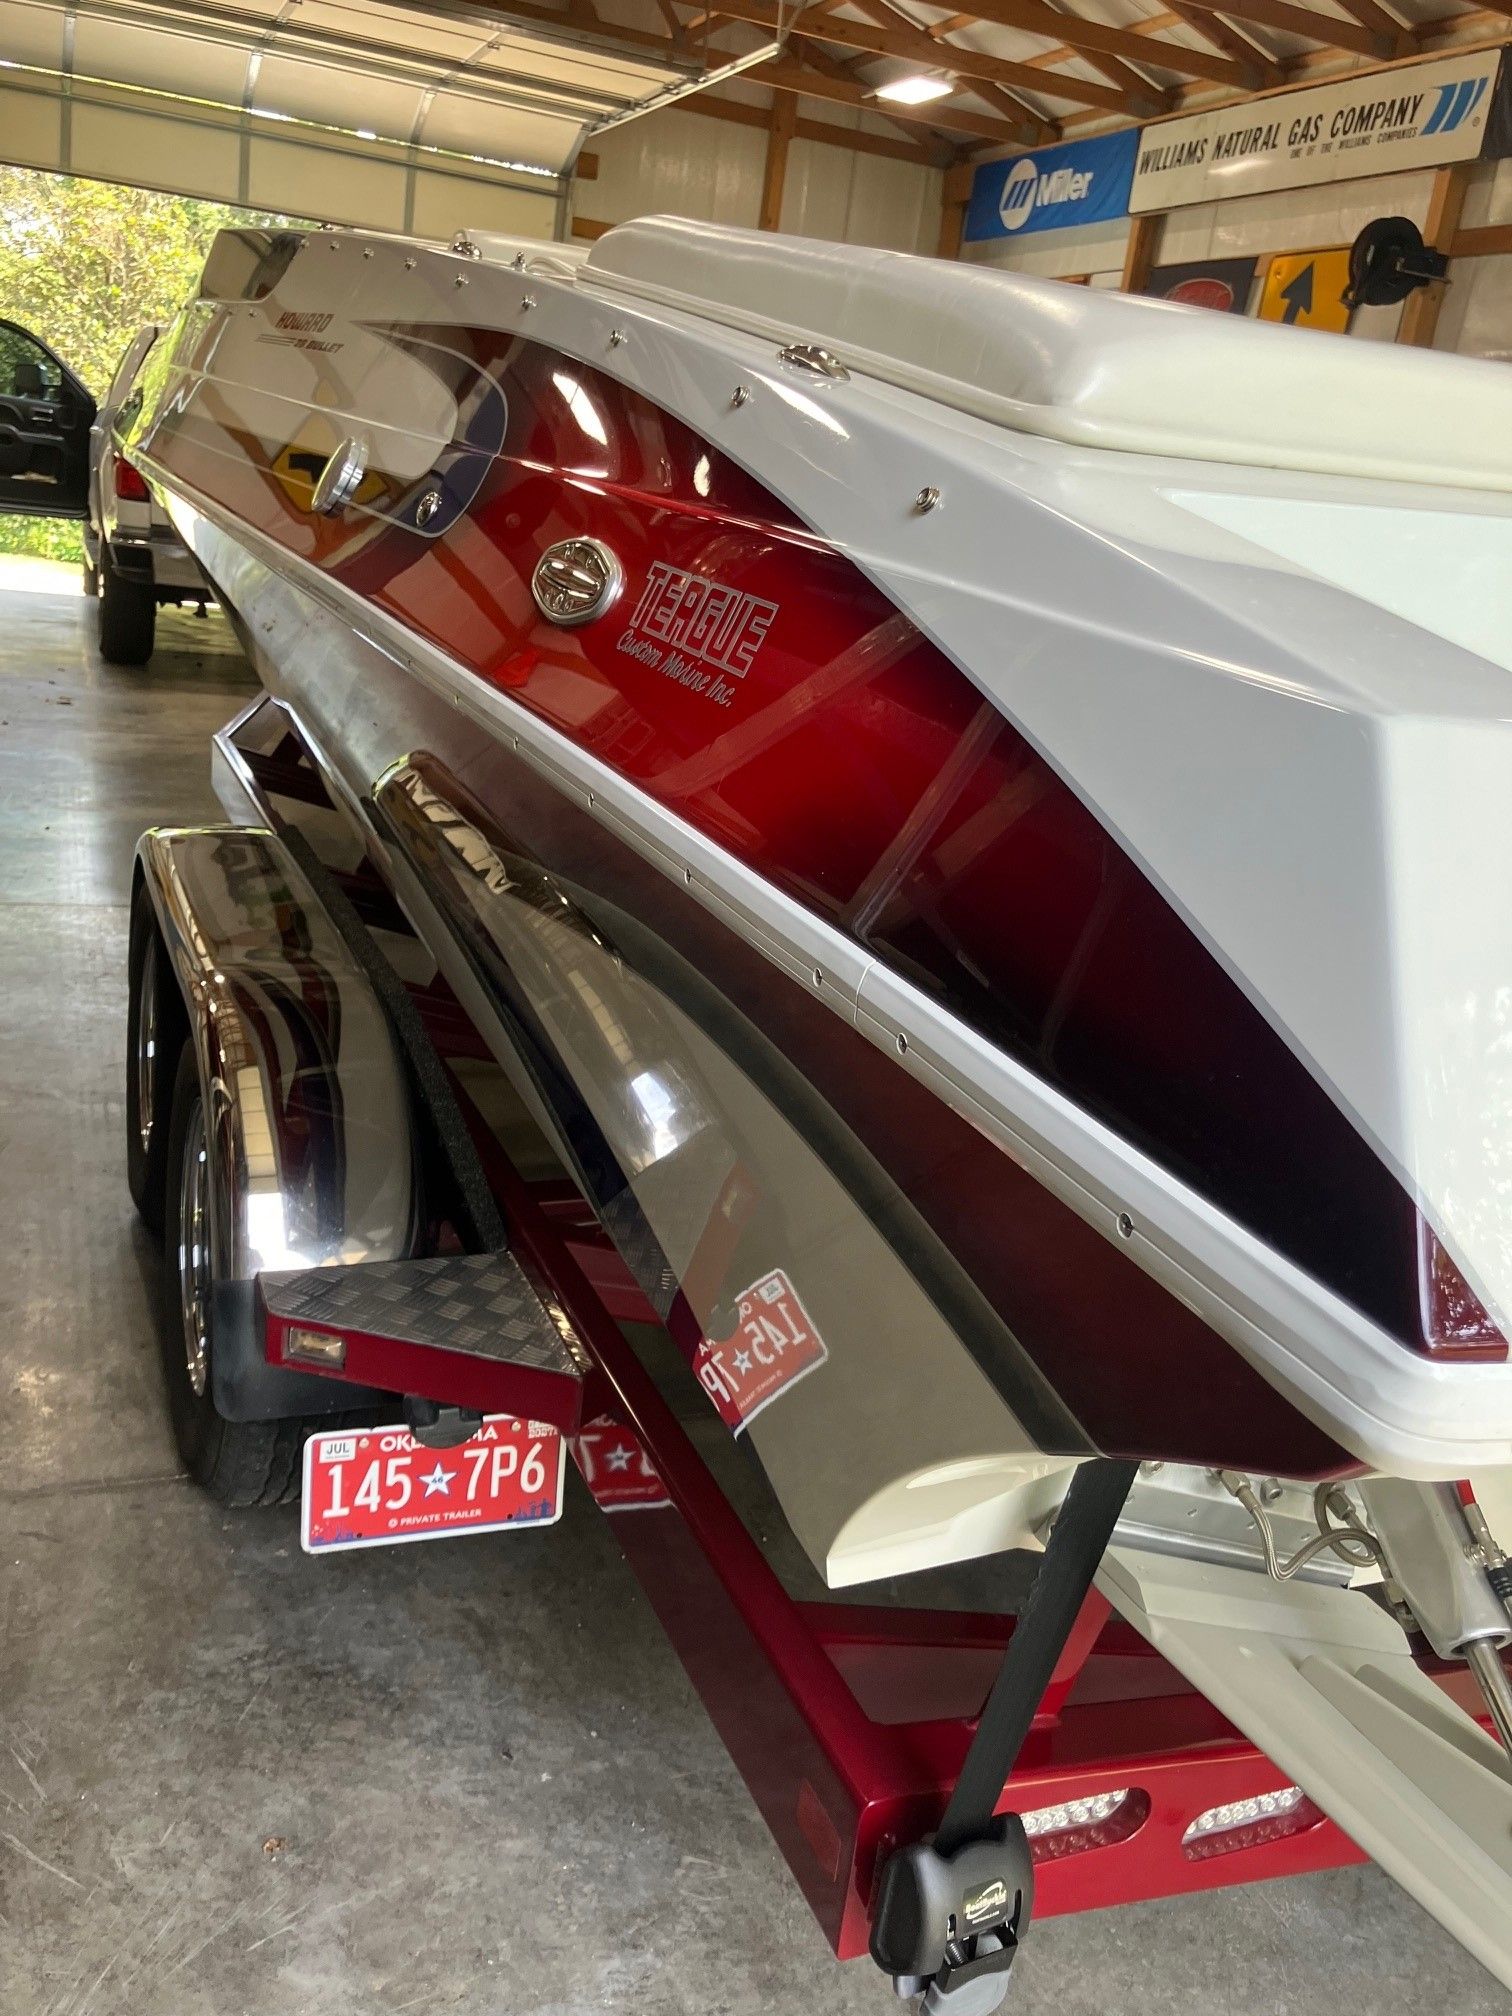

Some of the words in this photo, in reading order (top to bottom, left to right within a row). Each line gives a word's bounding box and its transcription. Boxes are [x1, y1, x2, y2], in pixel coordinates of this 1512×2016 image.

[1138, 138, 1208, 175] WILLIAMS
[1211, 123, 1281, 161] NATURAL
[1287, 114, 1323, 147] GAS
[1330, 94, 1425, 139] COMPANY
[1338, 134, 1372, 149] WILLIAMS
[1376, 127, 1418, 144] COMPANIES
[1035, 167, 1094, 207] Miller
[275, 312, 335, 333] HOWARD
[305, 340, 345, 353] BULLET
[628, 559, 780, 679] TEAGUE
[616, 628, 663, 668] Custom
[657, 650, 711, 692] Marine
[705, 674, 736, 707] Inc.
[326, 1442, 350, 1455] JUL
[322, 1456, 412, 1519] 145
[463, 1442, 546, 1501] 7P6
[400, 1513, 441, 1527] PRIVATE
[442, 1508, 482, 1521] TRAILER
